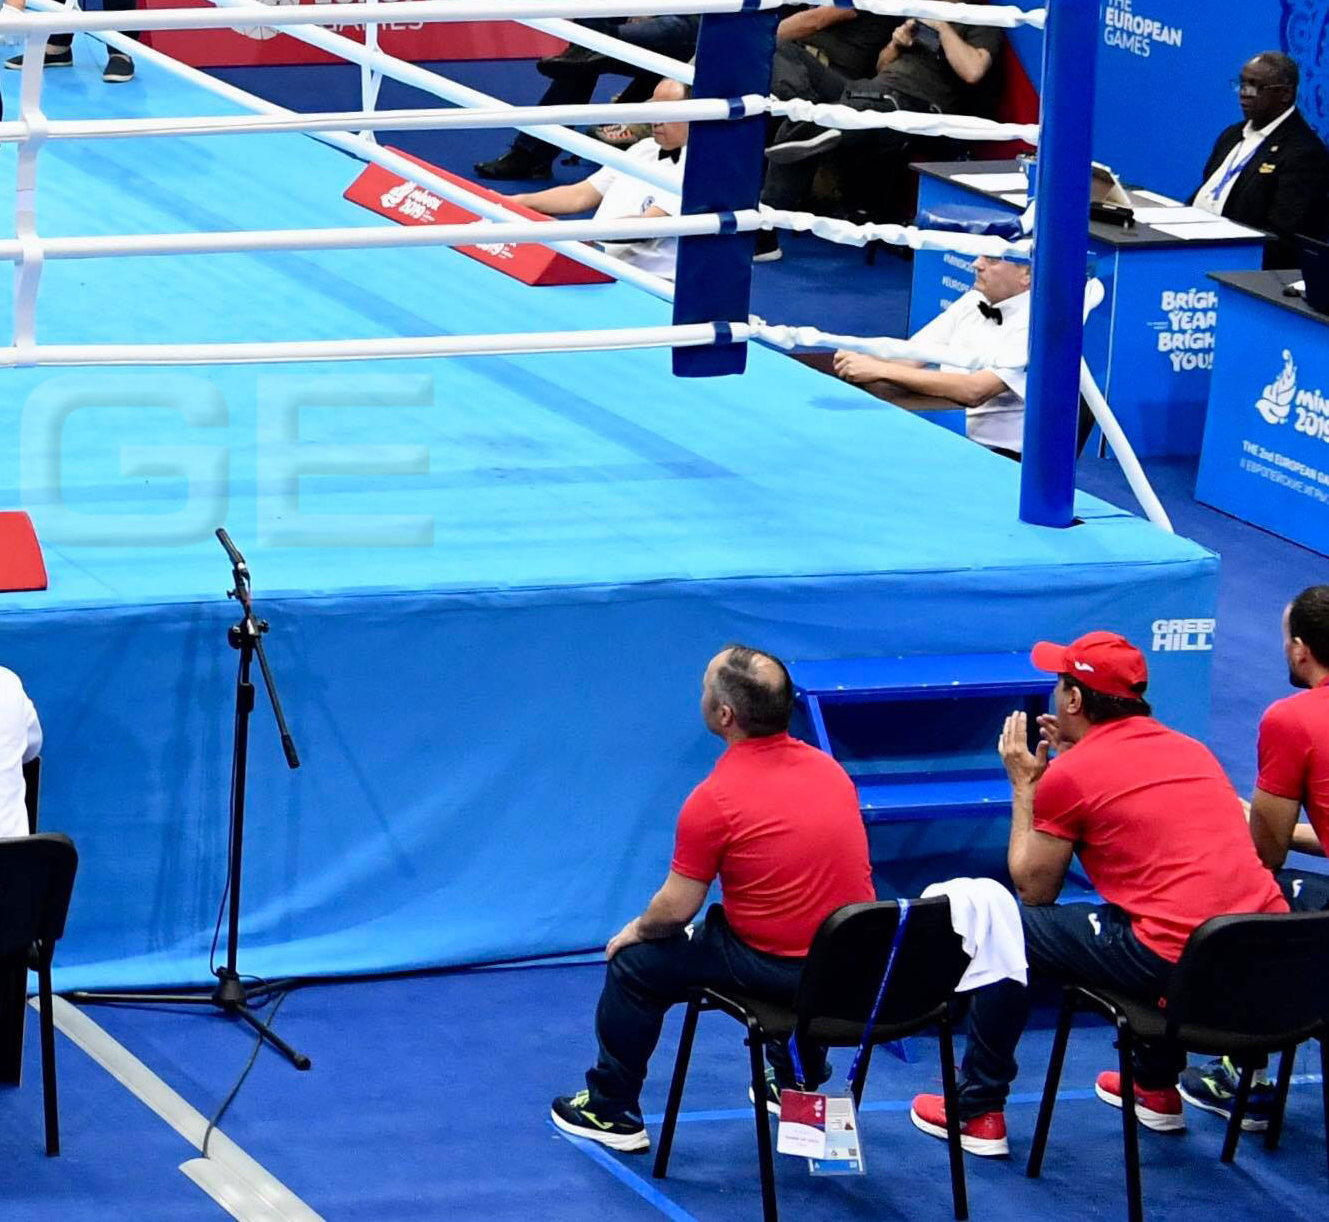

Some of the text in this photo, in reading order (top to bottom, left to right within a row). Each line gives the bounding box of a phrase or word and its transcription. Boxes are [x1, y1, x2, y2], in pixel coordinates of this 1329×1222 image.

[1105, 7, 1182, 47] EUROPEAN
[1104, 28, 1151, 57] GAMES
[1169, 351, 1214, 372] YOU!
[1274, 453, 1318, 482] EUROPEAN
[1151, 634, 1213, 651] HILL
